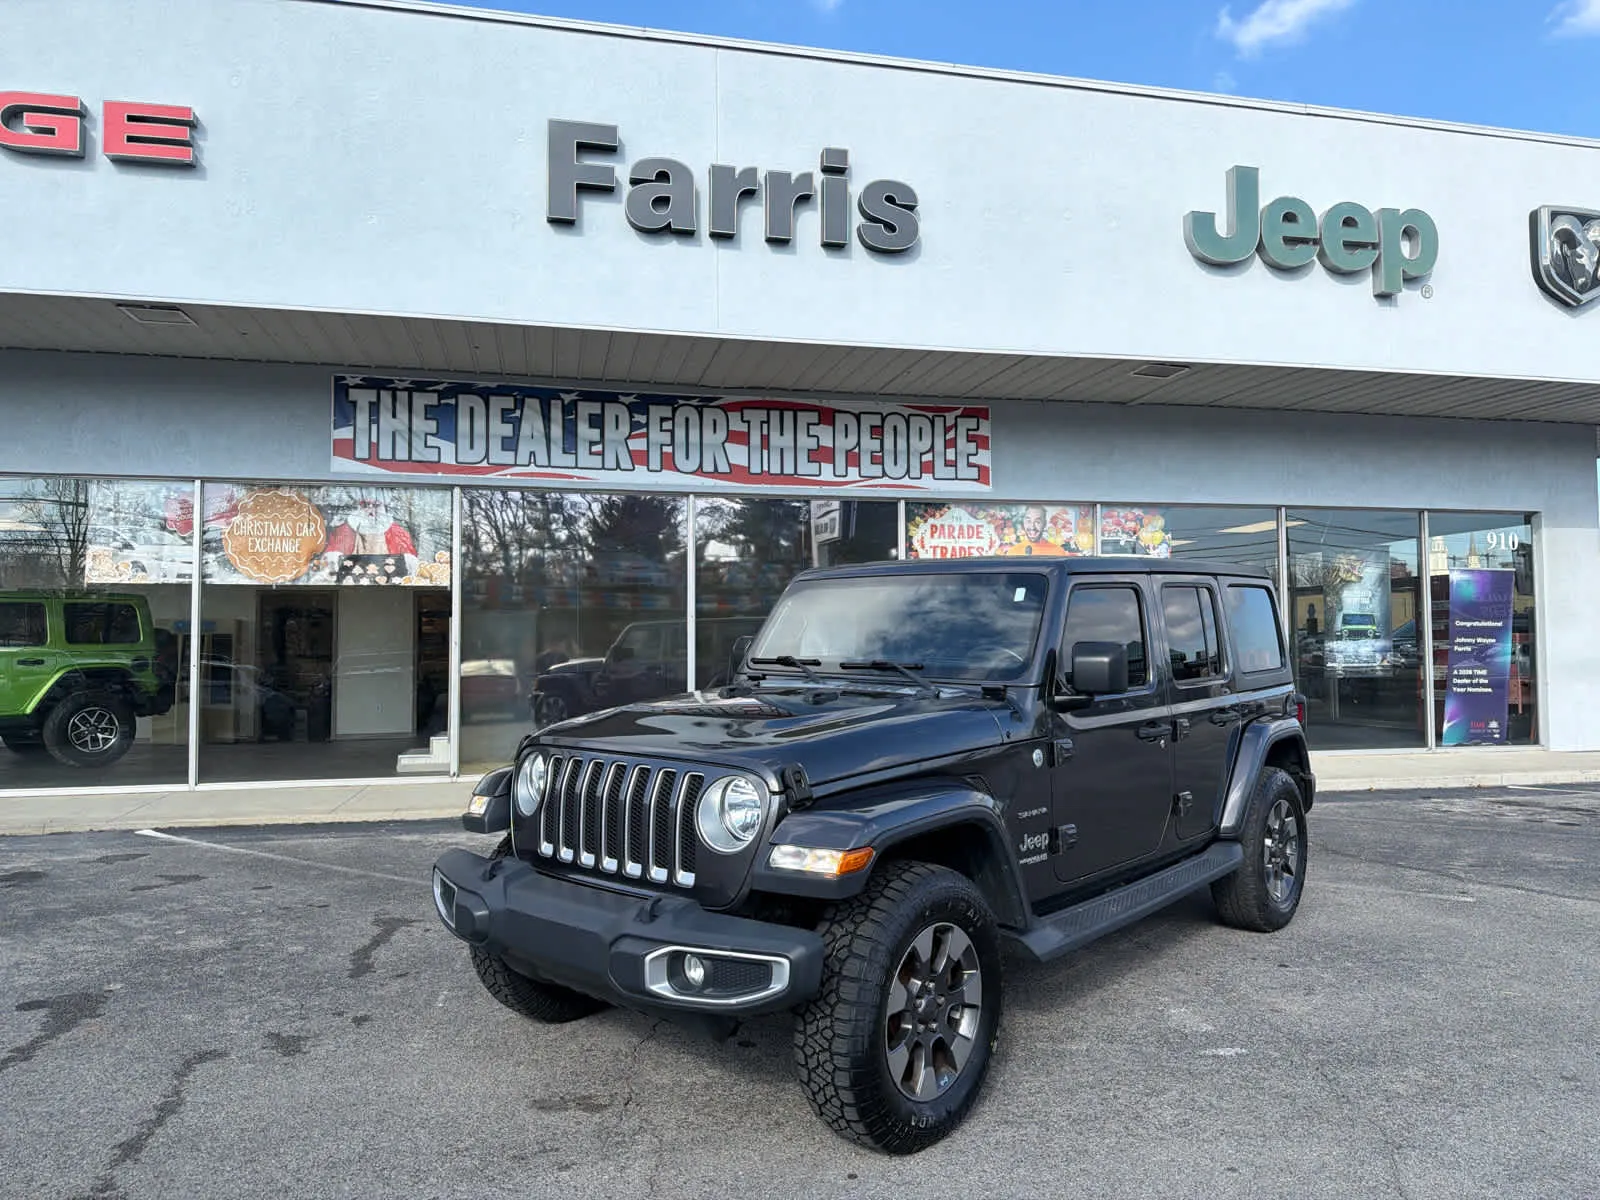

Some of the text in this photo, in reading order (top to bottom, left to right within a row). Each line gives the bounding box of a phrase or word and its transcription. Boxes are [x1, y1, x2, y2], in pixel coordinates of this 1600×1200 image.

[0, 91, 196, 167] GE
[547, 118, 919, 252] Farris
[1182, 165, 1439, 296] Jeep
[348, 387, 981, 480] THE DEALER FOR THE PEOPLE
[233, 520, 316, 537] CHRISTMAS CAR
[929, 523, 985, 540] PARADE
[248, 537, 302, 553] EXCHANGE
[1486, 531, 1519, 551] 910
[929, 545, 985, 559] TRADES
[1019, 832, 1049, 852] Jeep
